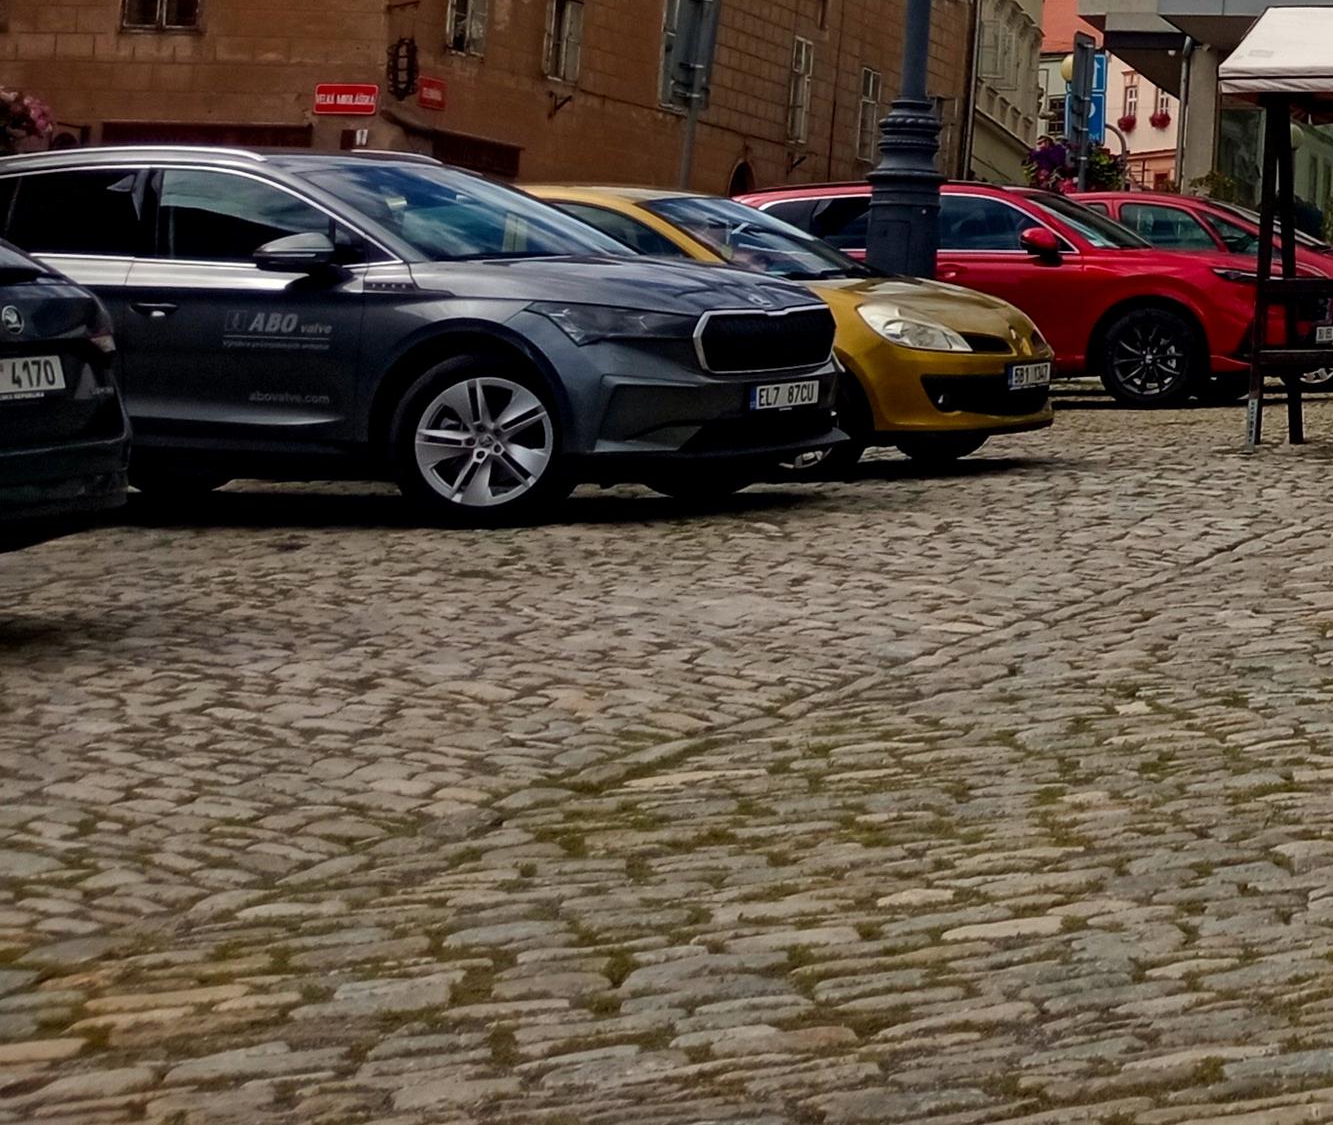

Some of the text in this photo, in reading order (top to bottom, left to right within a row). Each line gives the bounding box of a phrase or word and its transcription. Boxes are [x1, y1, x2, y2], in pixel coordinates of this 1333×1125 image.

[248, 312, 333, 334] ABO valve
[11, 359, 56, 388] 4170
[759, 383, 814, 407] EL7 87CU
